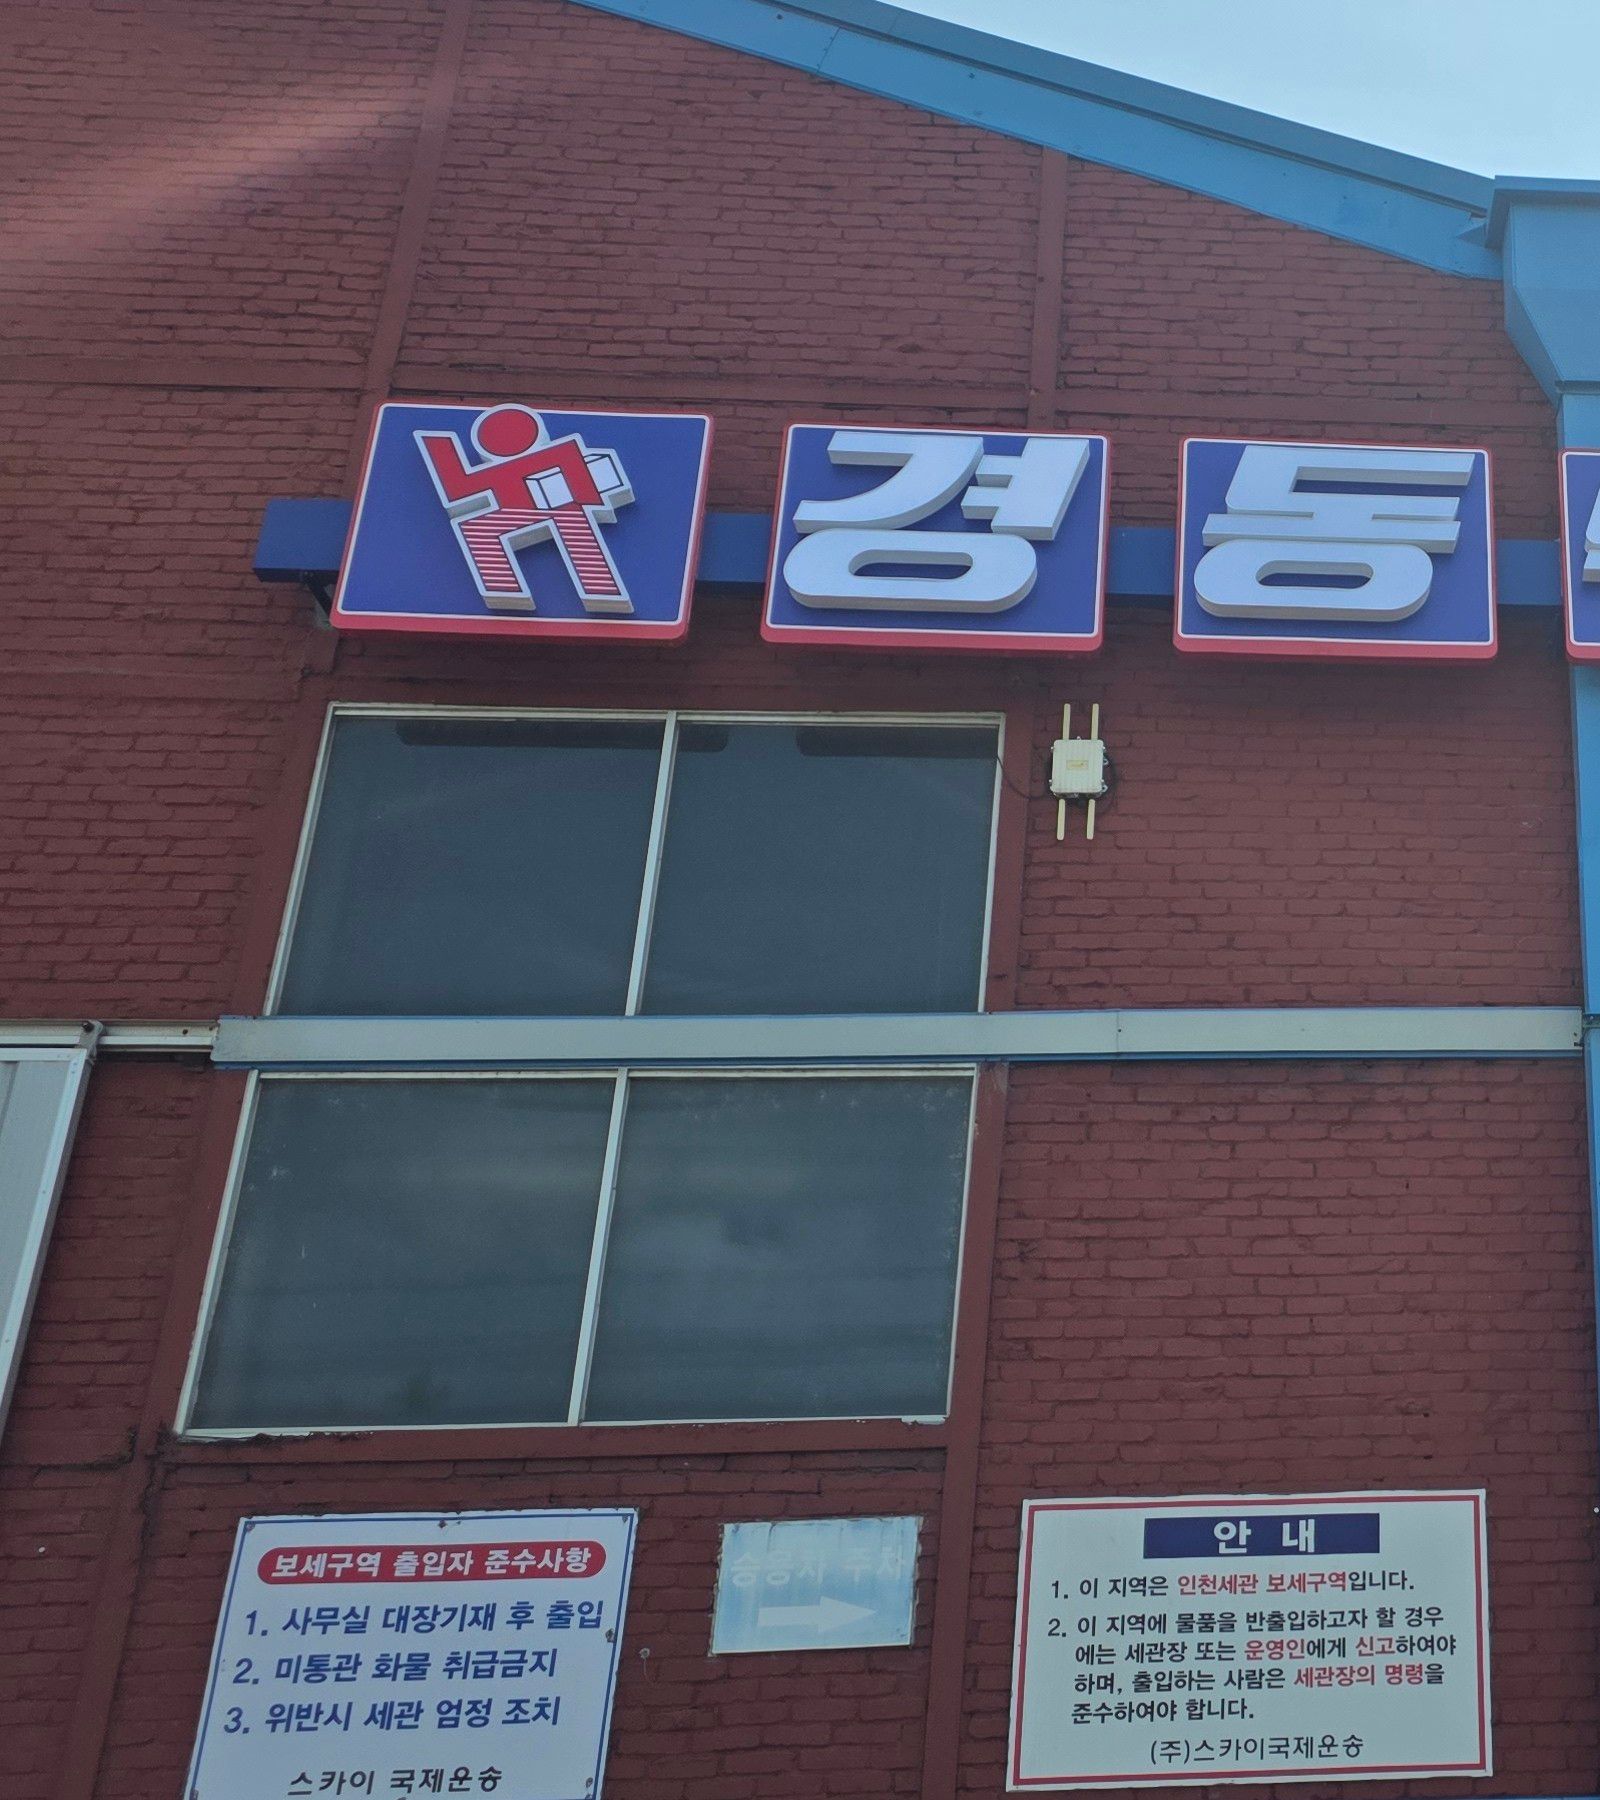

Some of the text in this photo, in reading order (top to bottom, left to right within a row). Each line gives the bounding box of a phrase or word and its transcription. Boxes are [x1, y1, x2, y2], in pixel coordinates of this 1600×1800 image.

[271, 1547, 591, 1579] 보세구역 출입자 준수사항
[1051, 1570, 1414, 1600] 1. 이 지역은 인천세관 보세구역입니다.
[246, 1600, 603, 1637] 1. 사무실 대장기재 후 출입
[1048, 1606, 1444, 1638] 2. 이 지역에 물품을 반출입하고자 할 경우
[1075, 1634, 1456, 1666] 에는 세관장 또는 운영인에게 신고하여야
[233, 1649, 557, 1685] 2. 미통관 화물 취급금지
[1074, 1664, 1445, 1695] 하며, 출입하는 사람은 세관장의 명령을
[223, 1697, 560, 1734] 3. 위반시 세관 엄정 조치
[1071, 1700, 1255, 1725] 준수하여야 합니다.
[1151, 1735, 1364, 1764] (주)스카이국제운송
[287, 1766, 502, 1796] 스카이 국제운송
